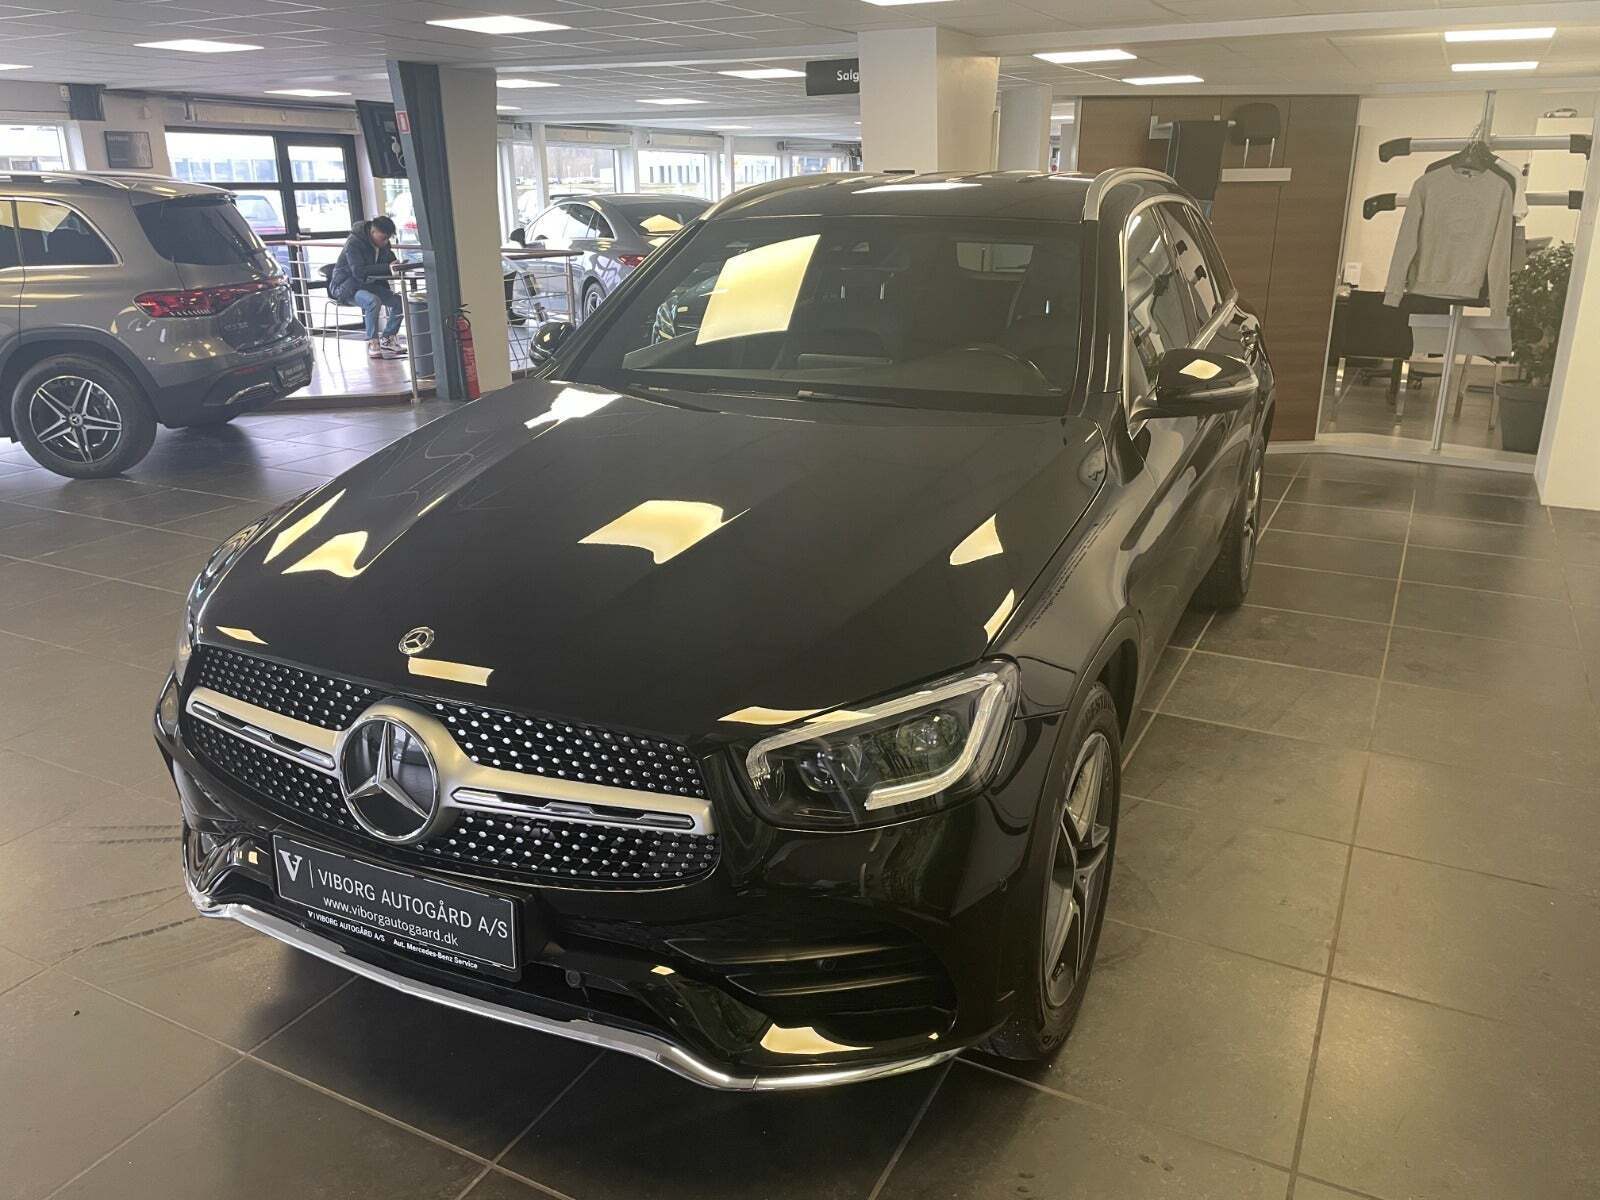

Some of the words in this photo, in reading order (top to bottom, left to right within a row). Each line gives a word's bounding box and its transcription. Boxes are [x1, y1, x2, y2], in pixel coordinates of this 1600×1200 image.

[317, 868, 376, 901] VIBORG
[381, 888, 472, 928] AUTOGÅRD
[478, 915, 508, 938] A/S
[323, 897, 459, 946] www.viborgautogaard.dk
[315, 912, 338, 927] VIBORG
[339, 921, 373, 938] AUTOGÅRD
[374, 932, 386, 942] A/S
[406, 942, 453, 962] Mercedes-Benz
[453, 955, 478, 969] Service
